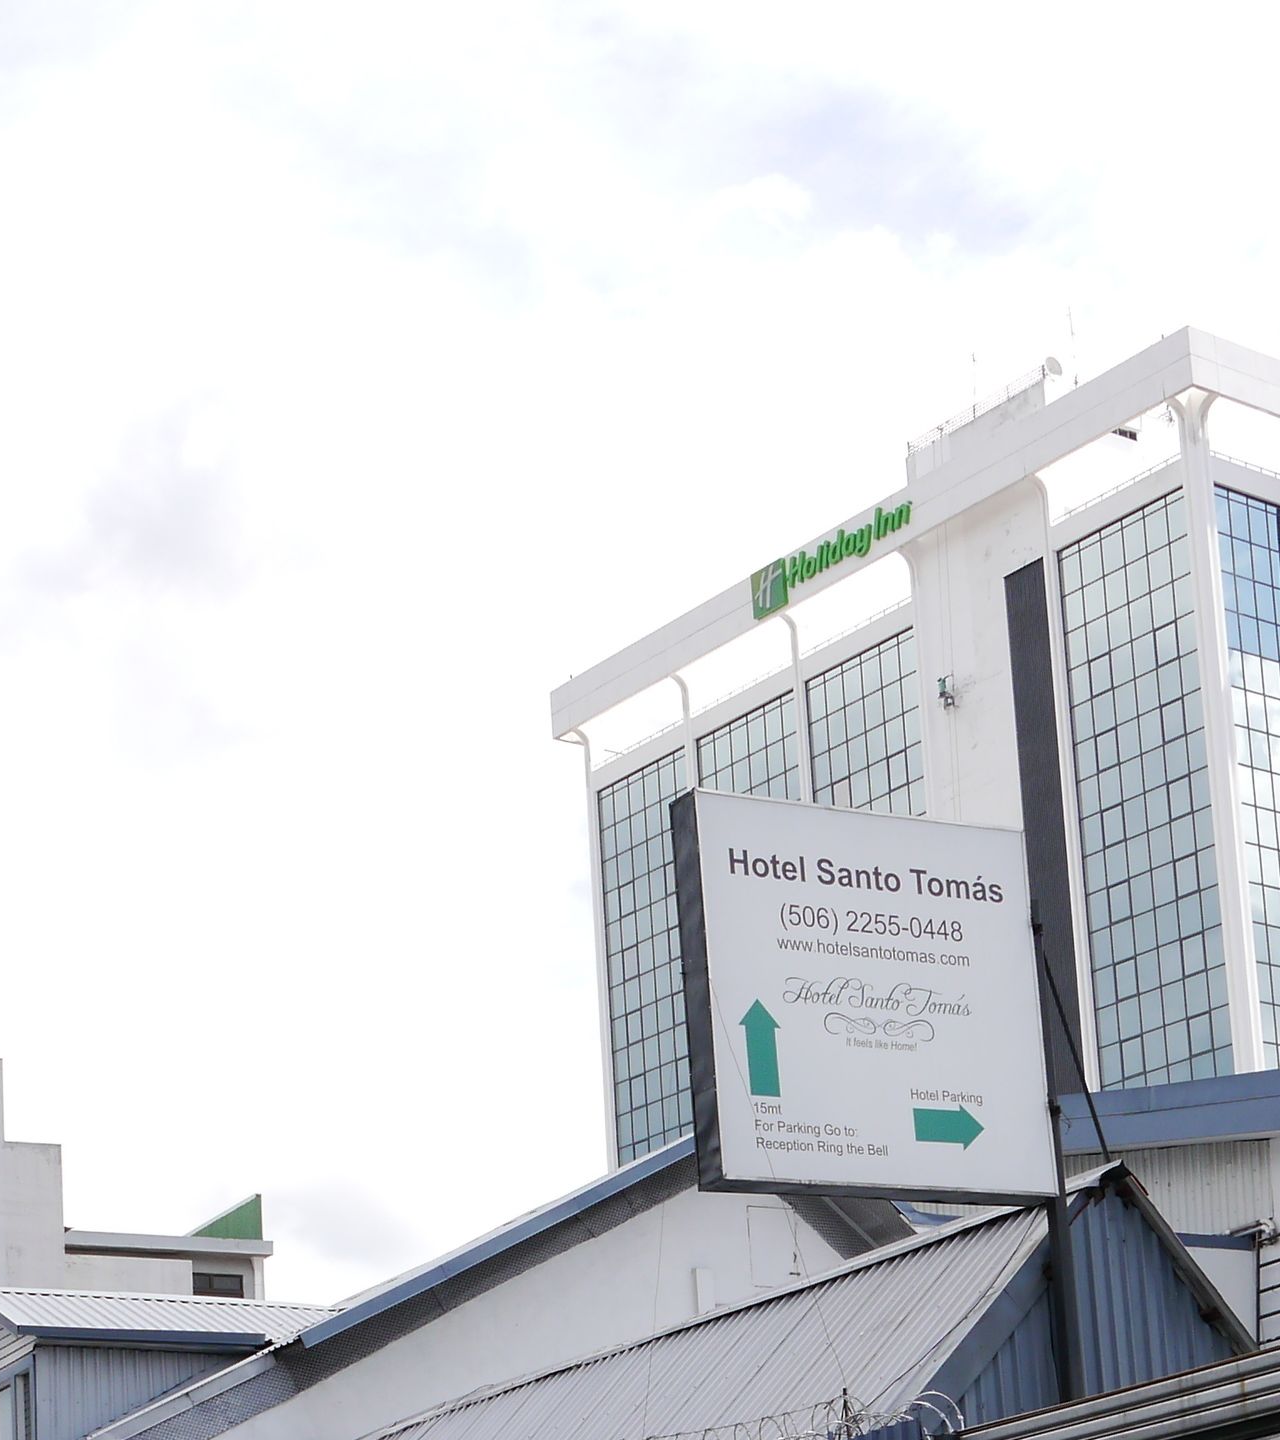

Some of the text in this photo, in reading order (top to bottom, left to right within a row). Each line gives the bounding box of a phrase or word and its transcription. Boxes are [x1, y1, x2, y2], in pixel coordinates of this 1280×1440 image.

[787, 502, 911, 588] Holiday Inn
[728, 848, 1003, 903] Hotel Santo Tomás
[780, 903, 963, 942] (506) 2255-0448
[777, 938, 970, 967] www.hotelsantotomas.com
[783, 977, 972, 1017] Hotel Santo Tomás
[853, 1037, 872, 1049] feels
[875, 1039, 888, 1050] like
[891, 1041, 918, 1052] Home!
[754, 1102, 782, 1115] 15mt
[910, 1088, 983, 1107] Hotel Parking
[754, 1119, 774, 1132] For
[777, 1121, 821, 1137] Parking
[824, 1124, 841, 1136] Go
[756, 1137, 889, 1156] Reception Ring the Bell
